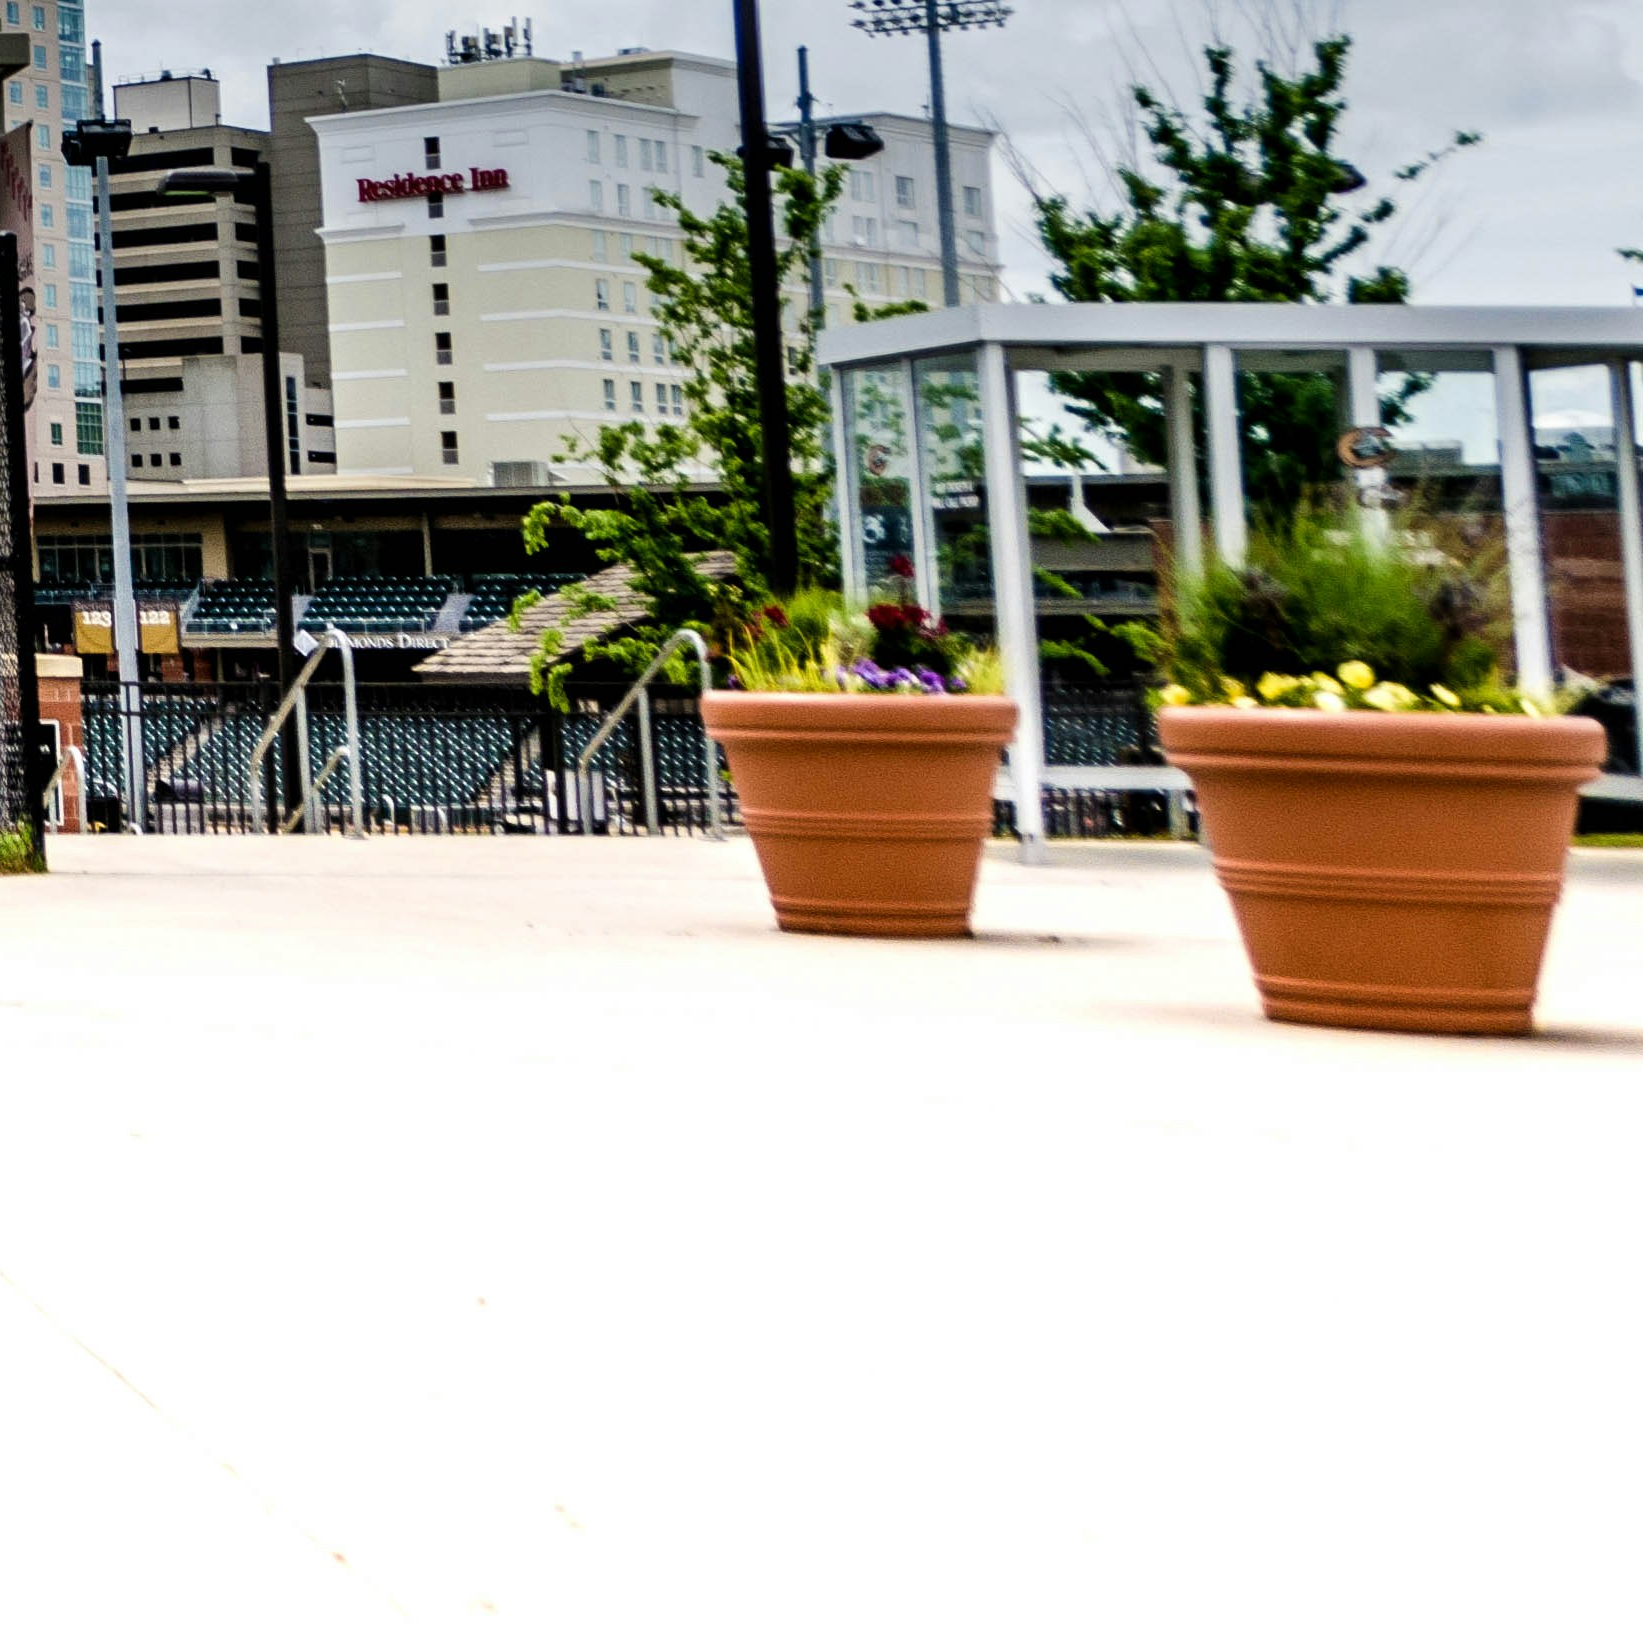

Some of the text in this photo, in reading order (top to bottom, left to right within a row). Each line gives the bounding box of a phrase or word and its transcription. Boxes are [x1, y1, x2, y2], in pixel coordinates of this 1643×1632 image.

[356, 167, 509, 203] Residence Inn
[82, 610, 112, 628] 123
[139, 610, 171, 626] 122
[397, 633, 450, 649] DIRECT
